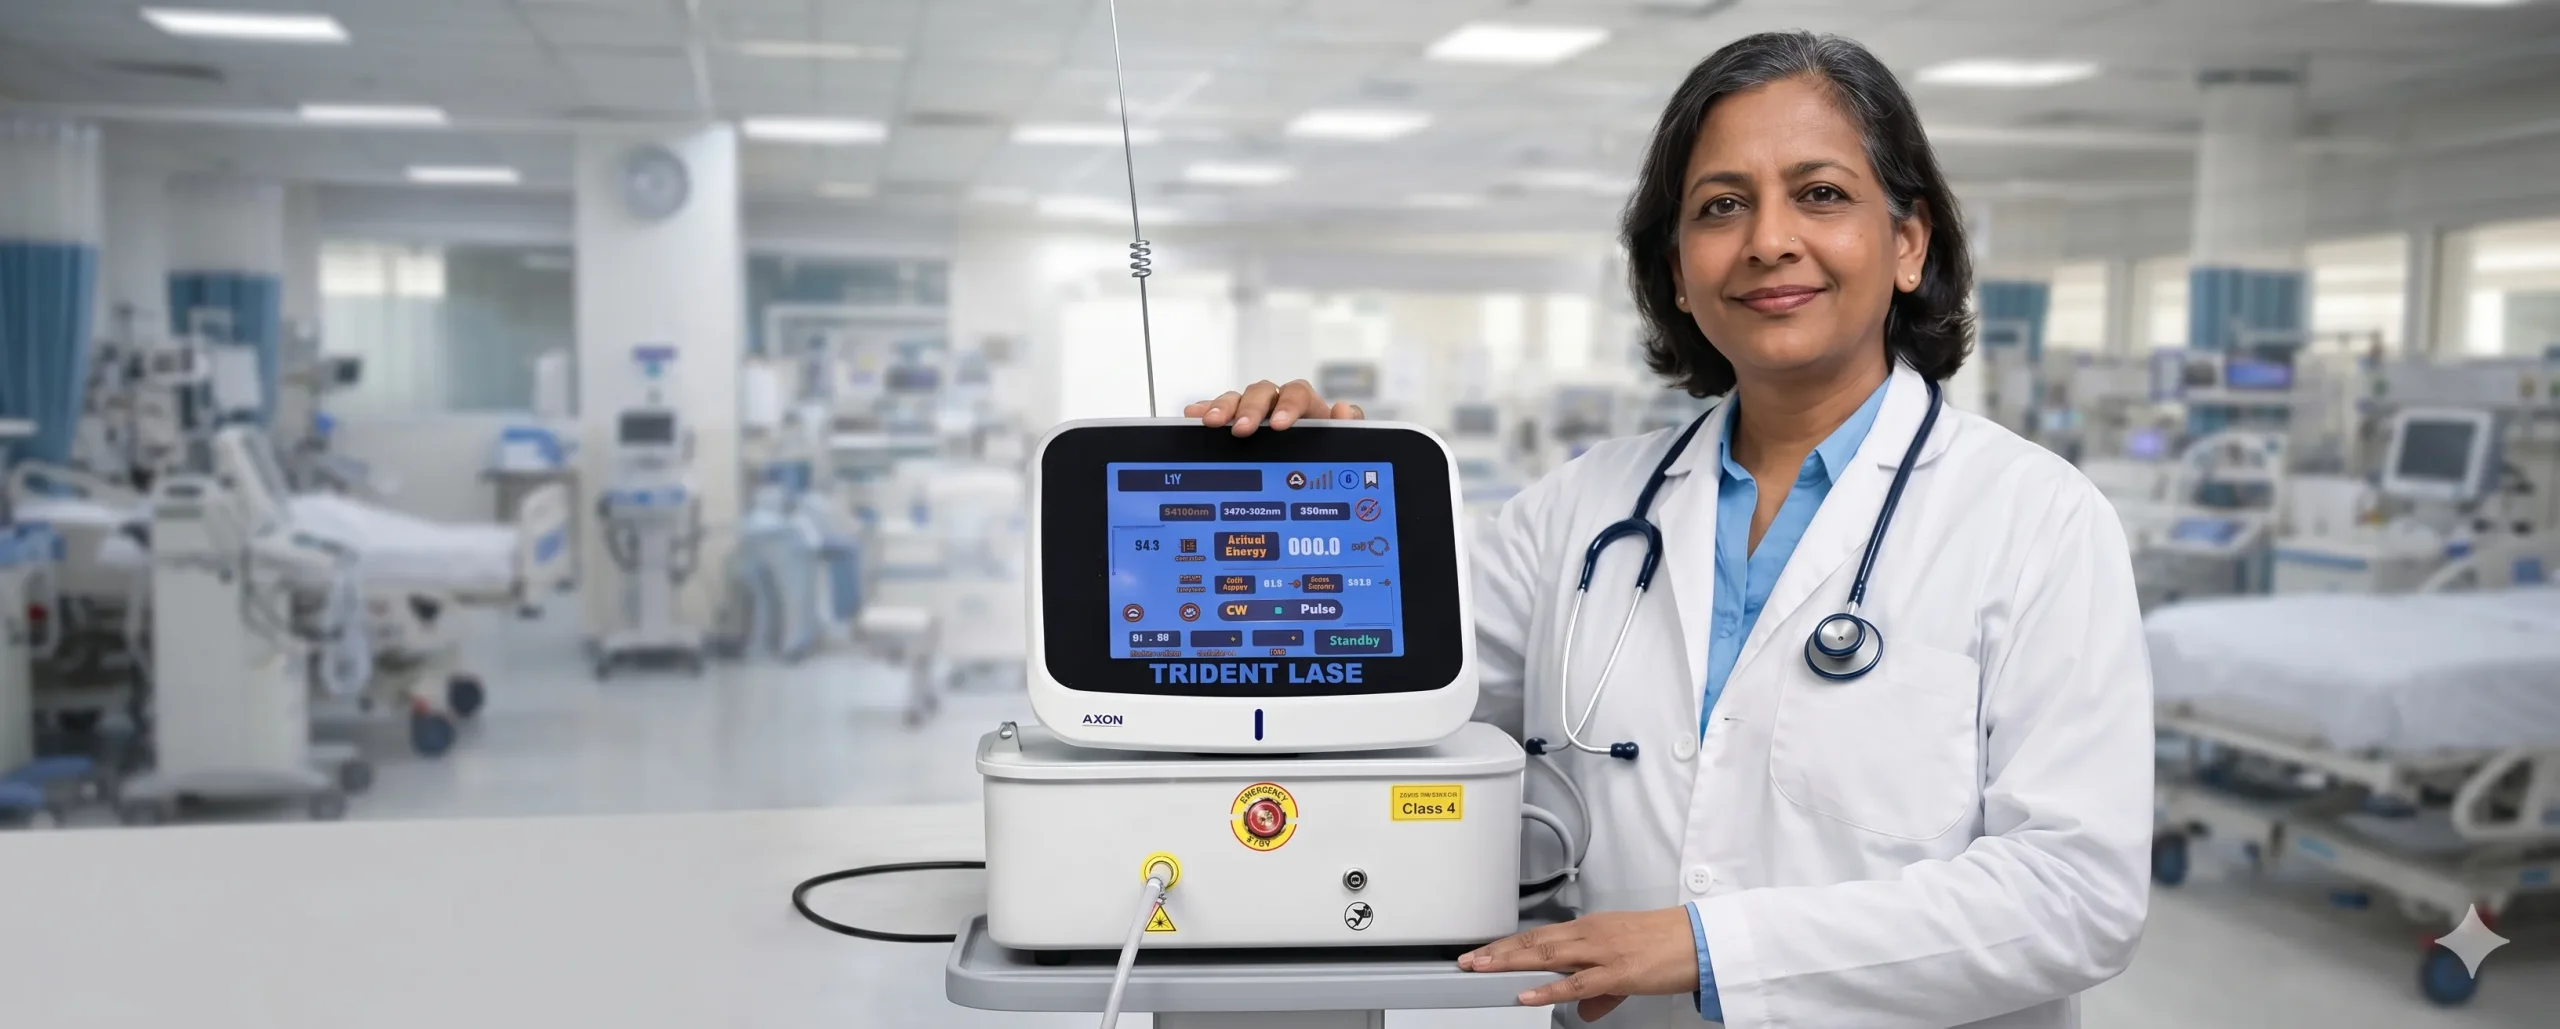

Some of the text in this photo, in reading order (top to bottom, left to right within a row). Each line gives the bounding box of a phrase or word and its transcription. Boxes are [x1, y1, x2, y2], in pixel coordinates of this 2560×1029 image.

[1300, 507, 1338, 515] 350mm
[1288, 537, 1341, 556] 000.0
[1226, 605, 1248, 615] CW
[1300, 603, 1337, 614] Pulse
[1330, 635, 1380, 648] Standby
[1149, 663, 1363, 684] TRIDENT LASE
[1082, 714, 1123, 725] AXON
[1239, 786, 1289, 804] EMERGENCY
[1402, 802, 1456, 814] Class 4
